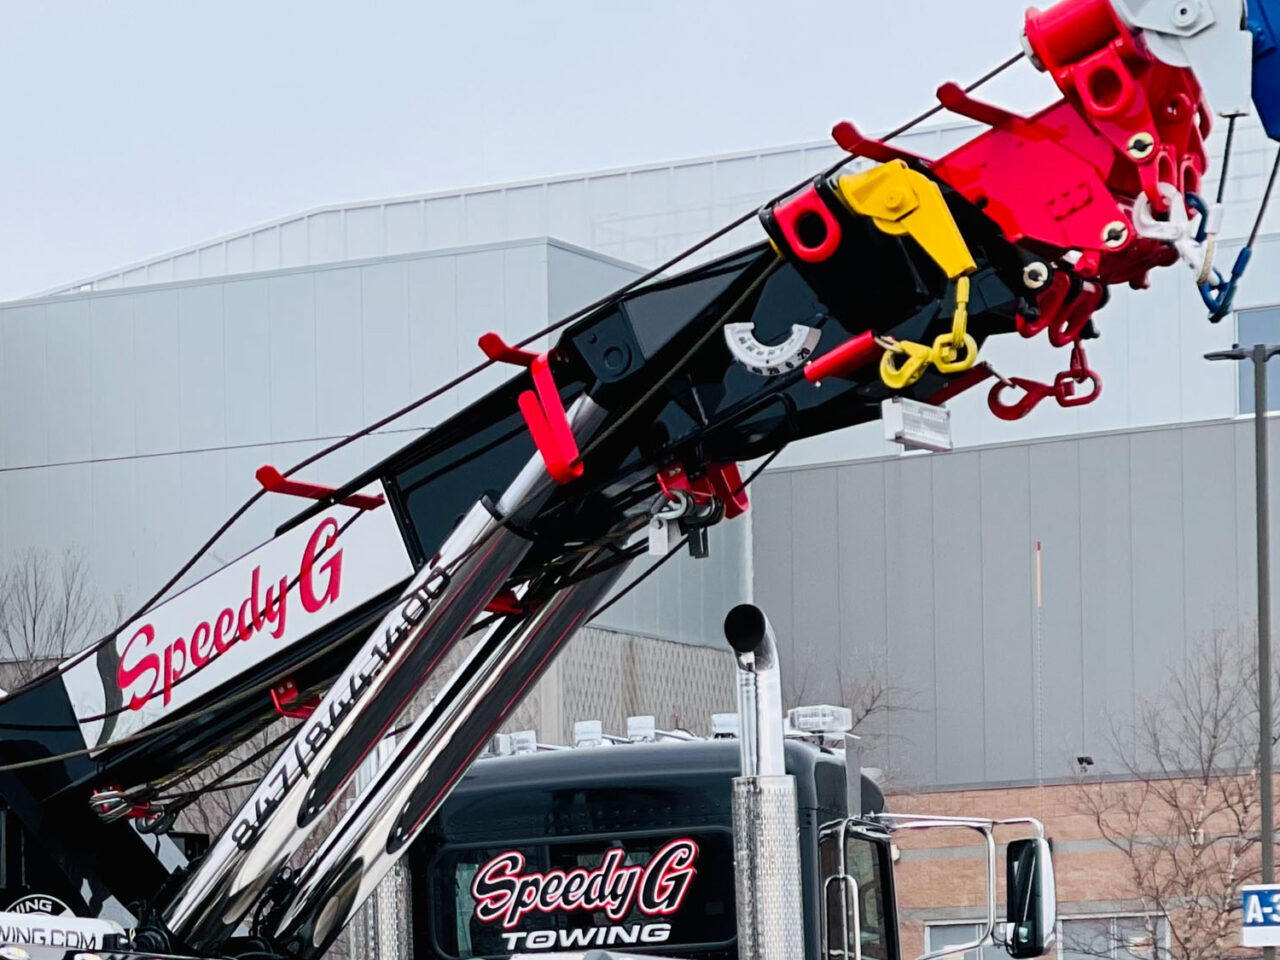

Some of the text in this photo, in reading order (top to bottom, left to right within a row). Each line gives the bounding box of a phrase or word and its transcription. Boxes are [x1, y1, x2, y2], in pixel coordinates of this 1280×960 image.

[116, 516, 344, 712] Speedy G
[472, 838, 699, 928] Speedy G
[501, 923, 672, 950] TOWING
